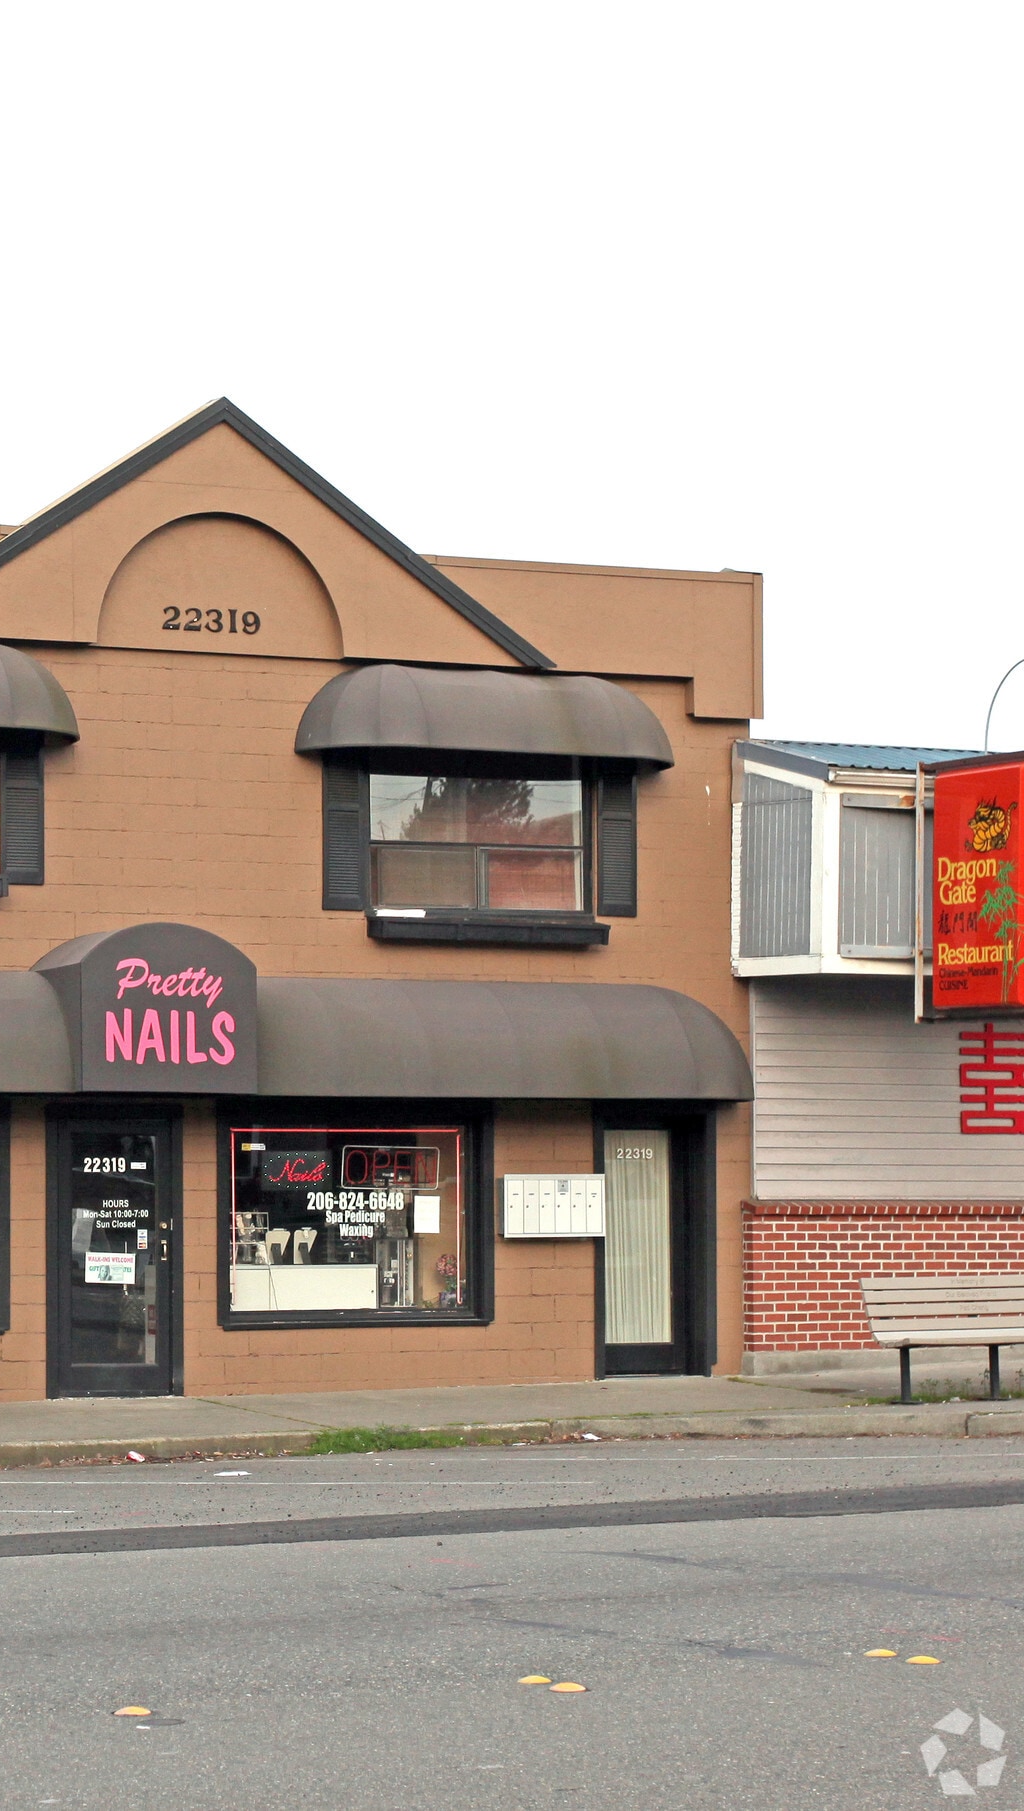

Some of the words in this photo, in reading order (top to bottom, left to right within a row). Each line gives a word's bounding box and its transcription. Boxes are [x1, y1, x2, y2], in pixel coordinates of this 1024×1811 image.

[162, 606, 262, 636] 22319
[937, 857, 997, 885] Dragon
[939, 880, 977, 905] Gate
[937, 939, 1014, 966] Restaurant
[116, 958, 223, 1008] Pretty
[105, 1007, 236, 1066] NAILS
[617, 1148, 653, 1159] 22319
[83, 1157, 126, 1173] 22319
[269, 1158, 327, 1183] Nails
[345, 1149, 438, 1186] OPEN
[102, 1199, 130, 1209] HOURS
[306, 1192, 405, 1211] 206-824-6648
[83, 1209, 112, 1219] Mon-Sat
[113, 1209, 149, 1218] 10:00-7:00
[325, 1211, 343, 1224] Spa
[344, 1210, 386, 1223] Pedicure
[96, 1219, 110, 1229] Sun
[111, 1219, 136, 1228] Closed
[339, 1223, 374, 1238] Waxing
[111, 1256, 134, 1264] WELCOME
